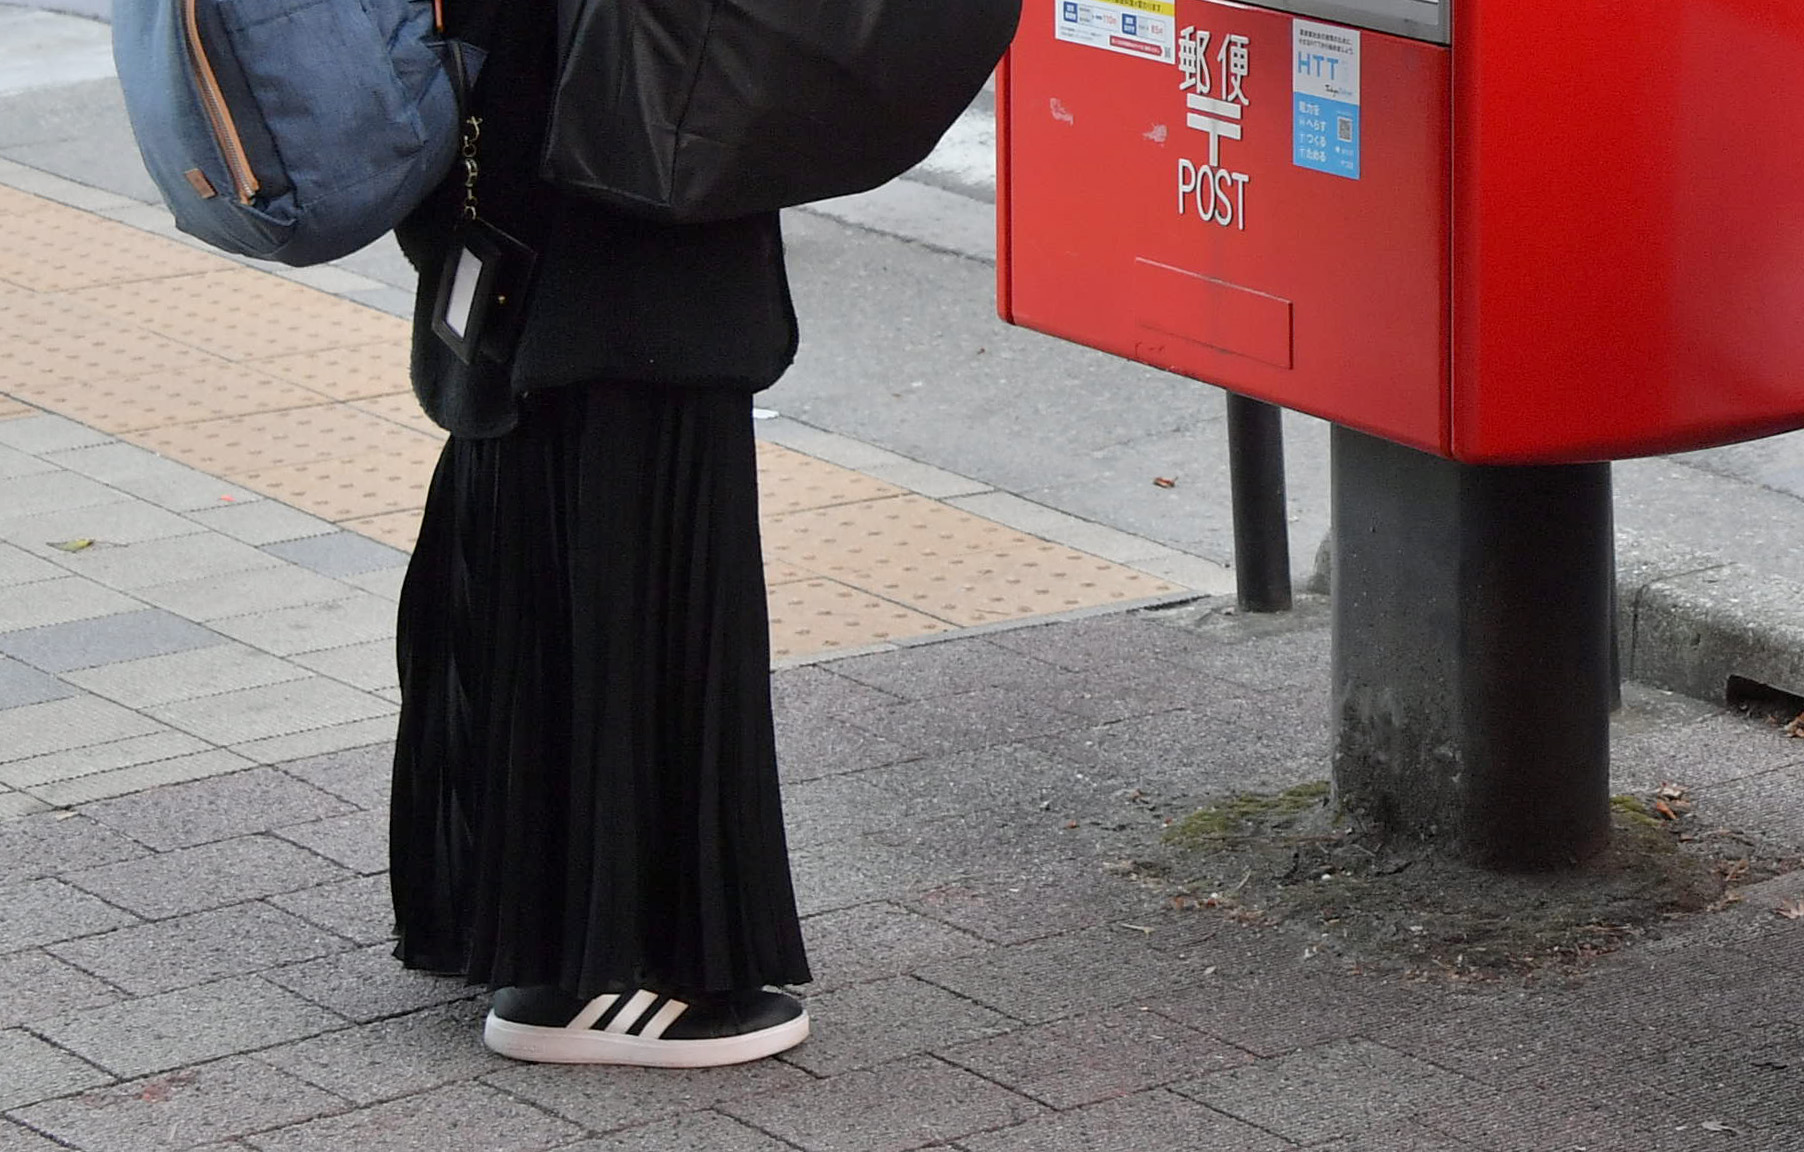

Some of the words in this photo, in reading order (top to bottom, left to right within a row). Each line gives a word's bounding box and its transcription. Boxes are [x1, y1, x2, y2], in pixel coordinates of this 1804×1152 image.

[1178, 25, 1251, 106] 郵便
[1297, 51, 1340, 81] HTT
[1178, 158, 1250, 231] POST
